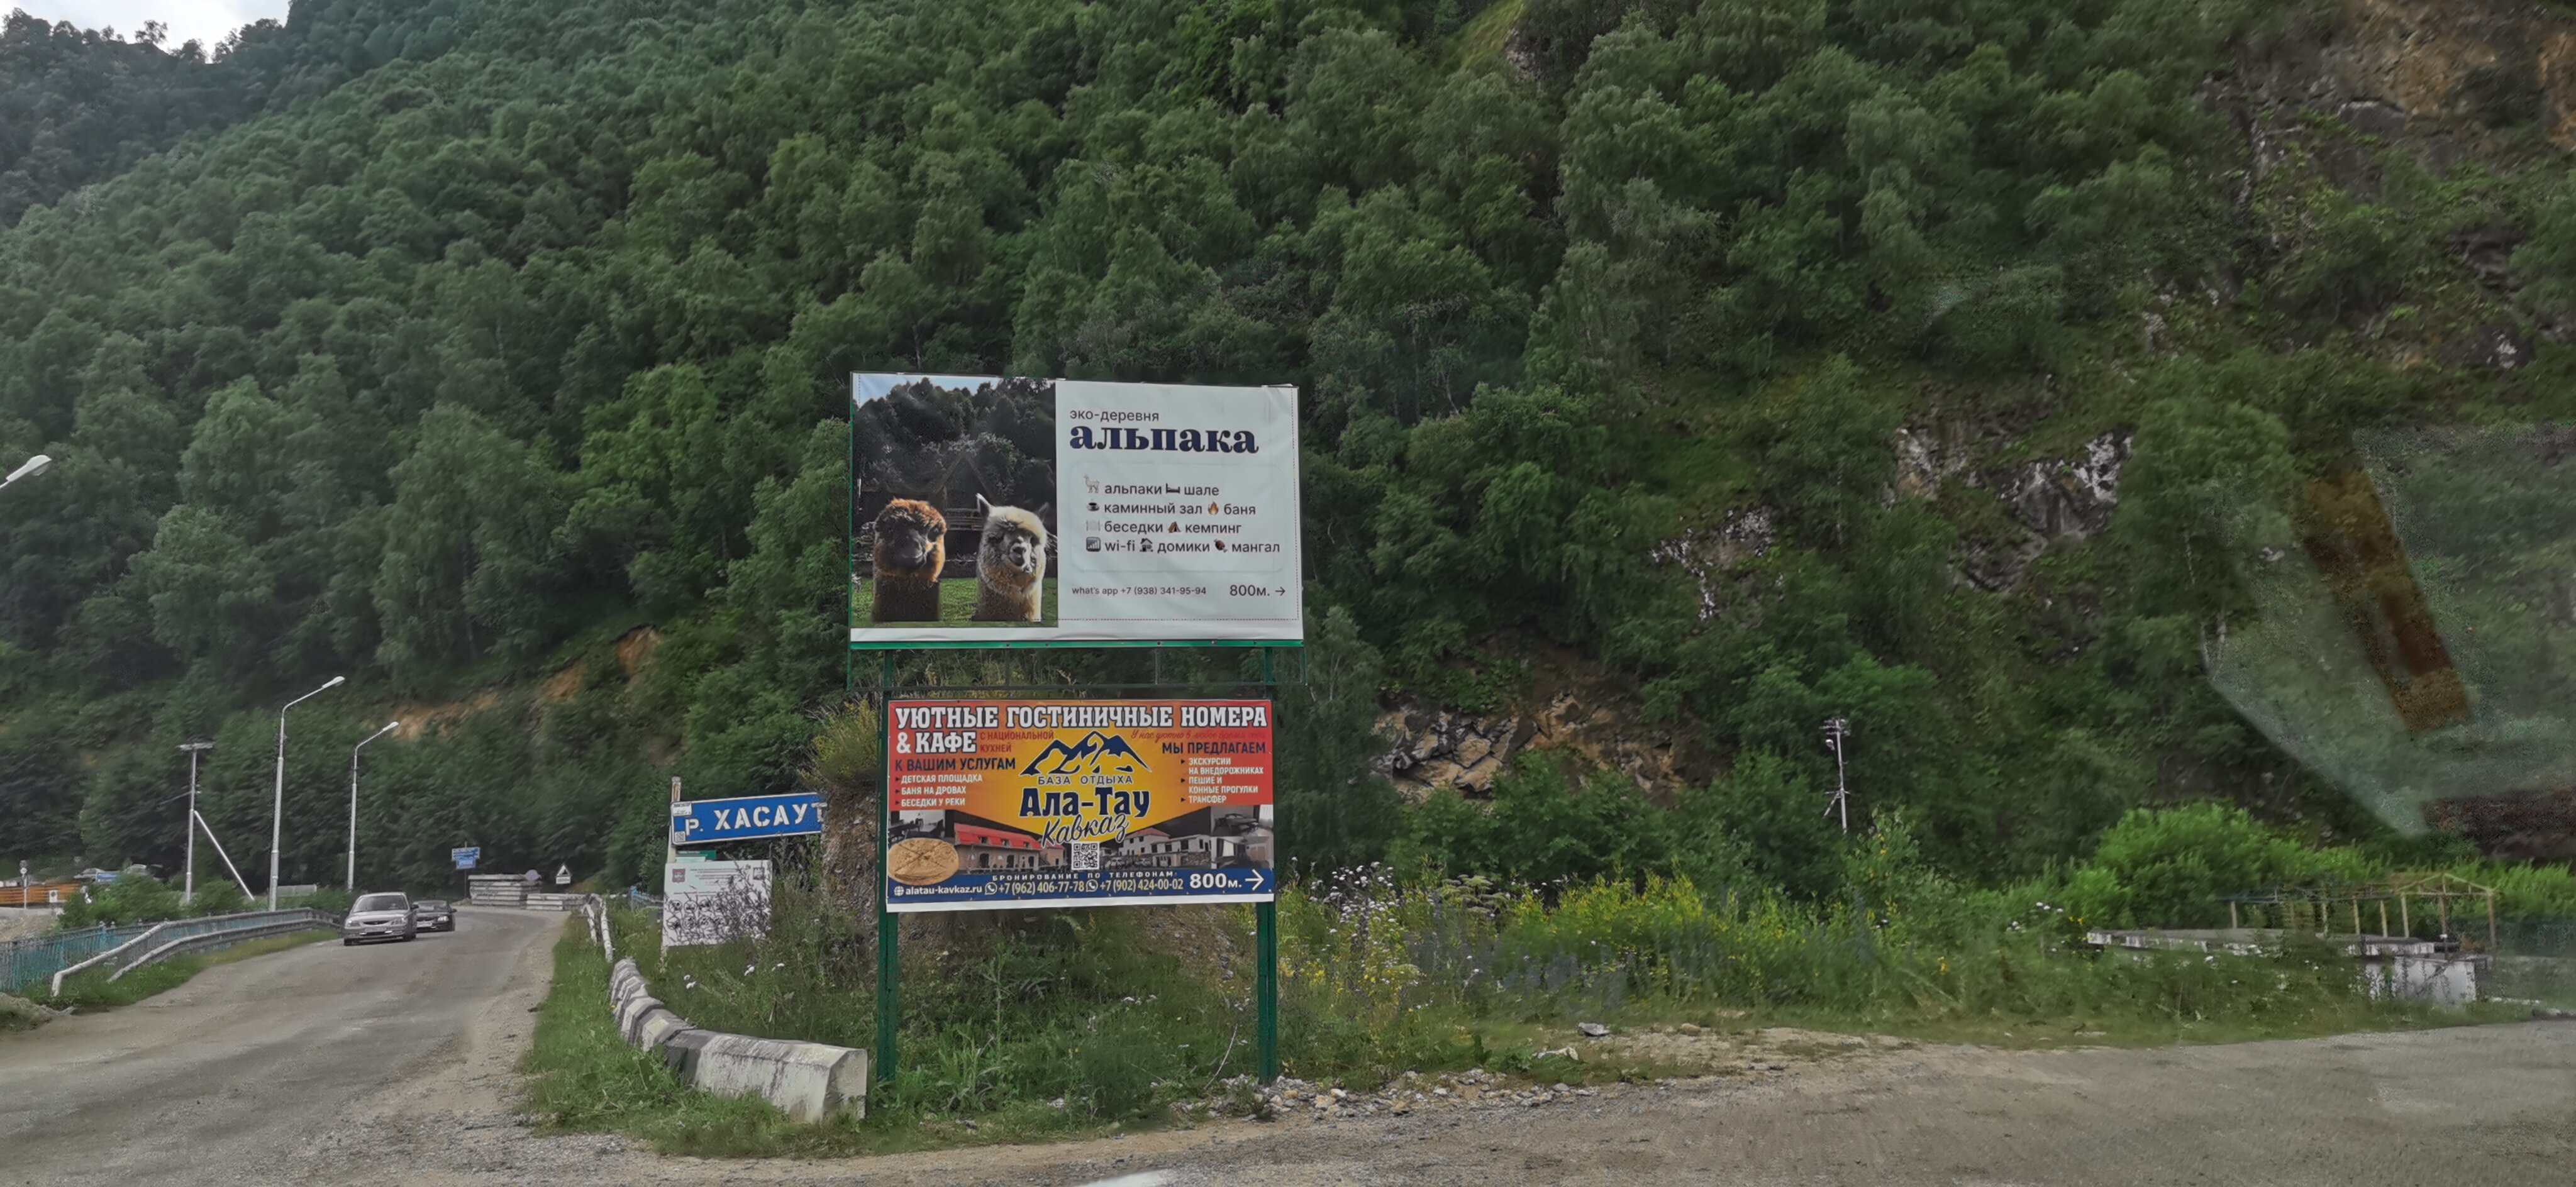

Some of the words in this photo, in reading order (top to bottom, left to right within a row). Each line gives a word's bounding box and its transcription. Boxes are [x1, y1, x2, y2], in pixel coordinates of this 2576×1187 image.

[1070, 409, 1159, 423] эко-деревня
[1069, 426, 1259, 454] альпака
[1104, 484, 1162, 495] альпаки
[1184, 485, 1219, 495] шале
[1104, 502, 1175, 514] каминный
[1180, 505, 1202, 514] зал
[1224, 504, 1256, 514] баня
[1104, 521, 1163, 534] беседки
[1185, 523, 1241, 534] кемпинг
[1105, 539, 1135, 551] wi-fi
[1157, 541, 1210, 553] домики
[1232, 542, 1280, 553] мангал
[1072, 587, 1100, 595] what's
[1102, 588, 1118, 596] app
[1134, 587, 1157, 595] (938)
[1160, 587, 1206, 595] 341-95-94
[895, 705, 999, 729] УЮТНЫЕ
[1006, 705, 1174, 729] ГОСТИНИЧНЫЕ
[1180, 705, 1268, 728] НОМЕРА
[987, 731, 1054, 741] НАЦИОНАЛЬНОЙ
[1130, 729, 1139, 739] У
[896, 731, 911, 754] &
[915, 731, 977, 754] КАФЕ
[980, 743, 1012, 753] КУХНЕЙ
[1162, 742, 1184, 754] МЫ
[1187, 742, 1266, 755] ПРЕДЛАГАЕМ
[895, 759, 902, 771] К
[907, 758, 956, 771] ВАШИМ
[960, 758, 1016, 771] УСЛУГАМ
[1188, 758, 1231, 766] ЭКСКУРСИИ
[1189, 766, 1199, 775] НА
[1200, 766, 1264, 776] ВНЕДОРОЖНИКАХ
[901, 775, 936, 784] ДЕТСКАЯ
[938, 774, 983, 783] ПЛОЩАДКА
[1038, 776, 1070, 785] БАЗА
[1080, 775, 1133, 785] ОТДЫХА
[1189, 776, 1215, 785] ПЕШИЕ
[1216, 776, 1223, 785] И
[901, 787, 922, 795] БАНЯ
[924, 787, 935, 795] НА
[936, 786, 967, 795] ДРОВАХ
[1221, 785, 1258, 793] ПРОГУЛКИ
[901, 798, 937, 807] БЕСЕДКИ
[939, 798, 943, 806] У
[945, 798, 965, 806] РЕКИ
[1019, 787, 1150, 817] Ала-Тау
[1188, 795, 1227, 803] ТРАНСФЕР
[1041, 813, 1130, 848] Кавказ
[992, 873, 1079, 881] БРОНИРОВАНИЕ
[905, 885, 982, 895] alatau-kavkaz.ru
[999, 883, 1010, 893] +7
[1011, 881, 1036, 895] (962)
[1037, 881, 1085, 893] 406-77-78
[1101, 880, 1111, 891] +7
[1113, 880, 1136, 893] (902)
[1138, 878, 1184, 891] 424-00-02
